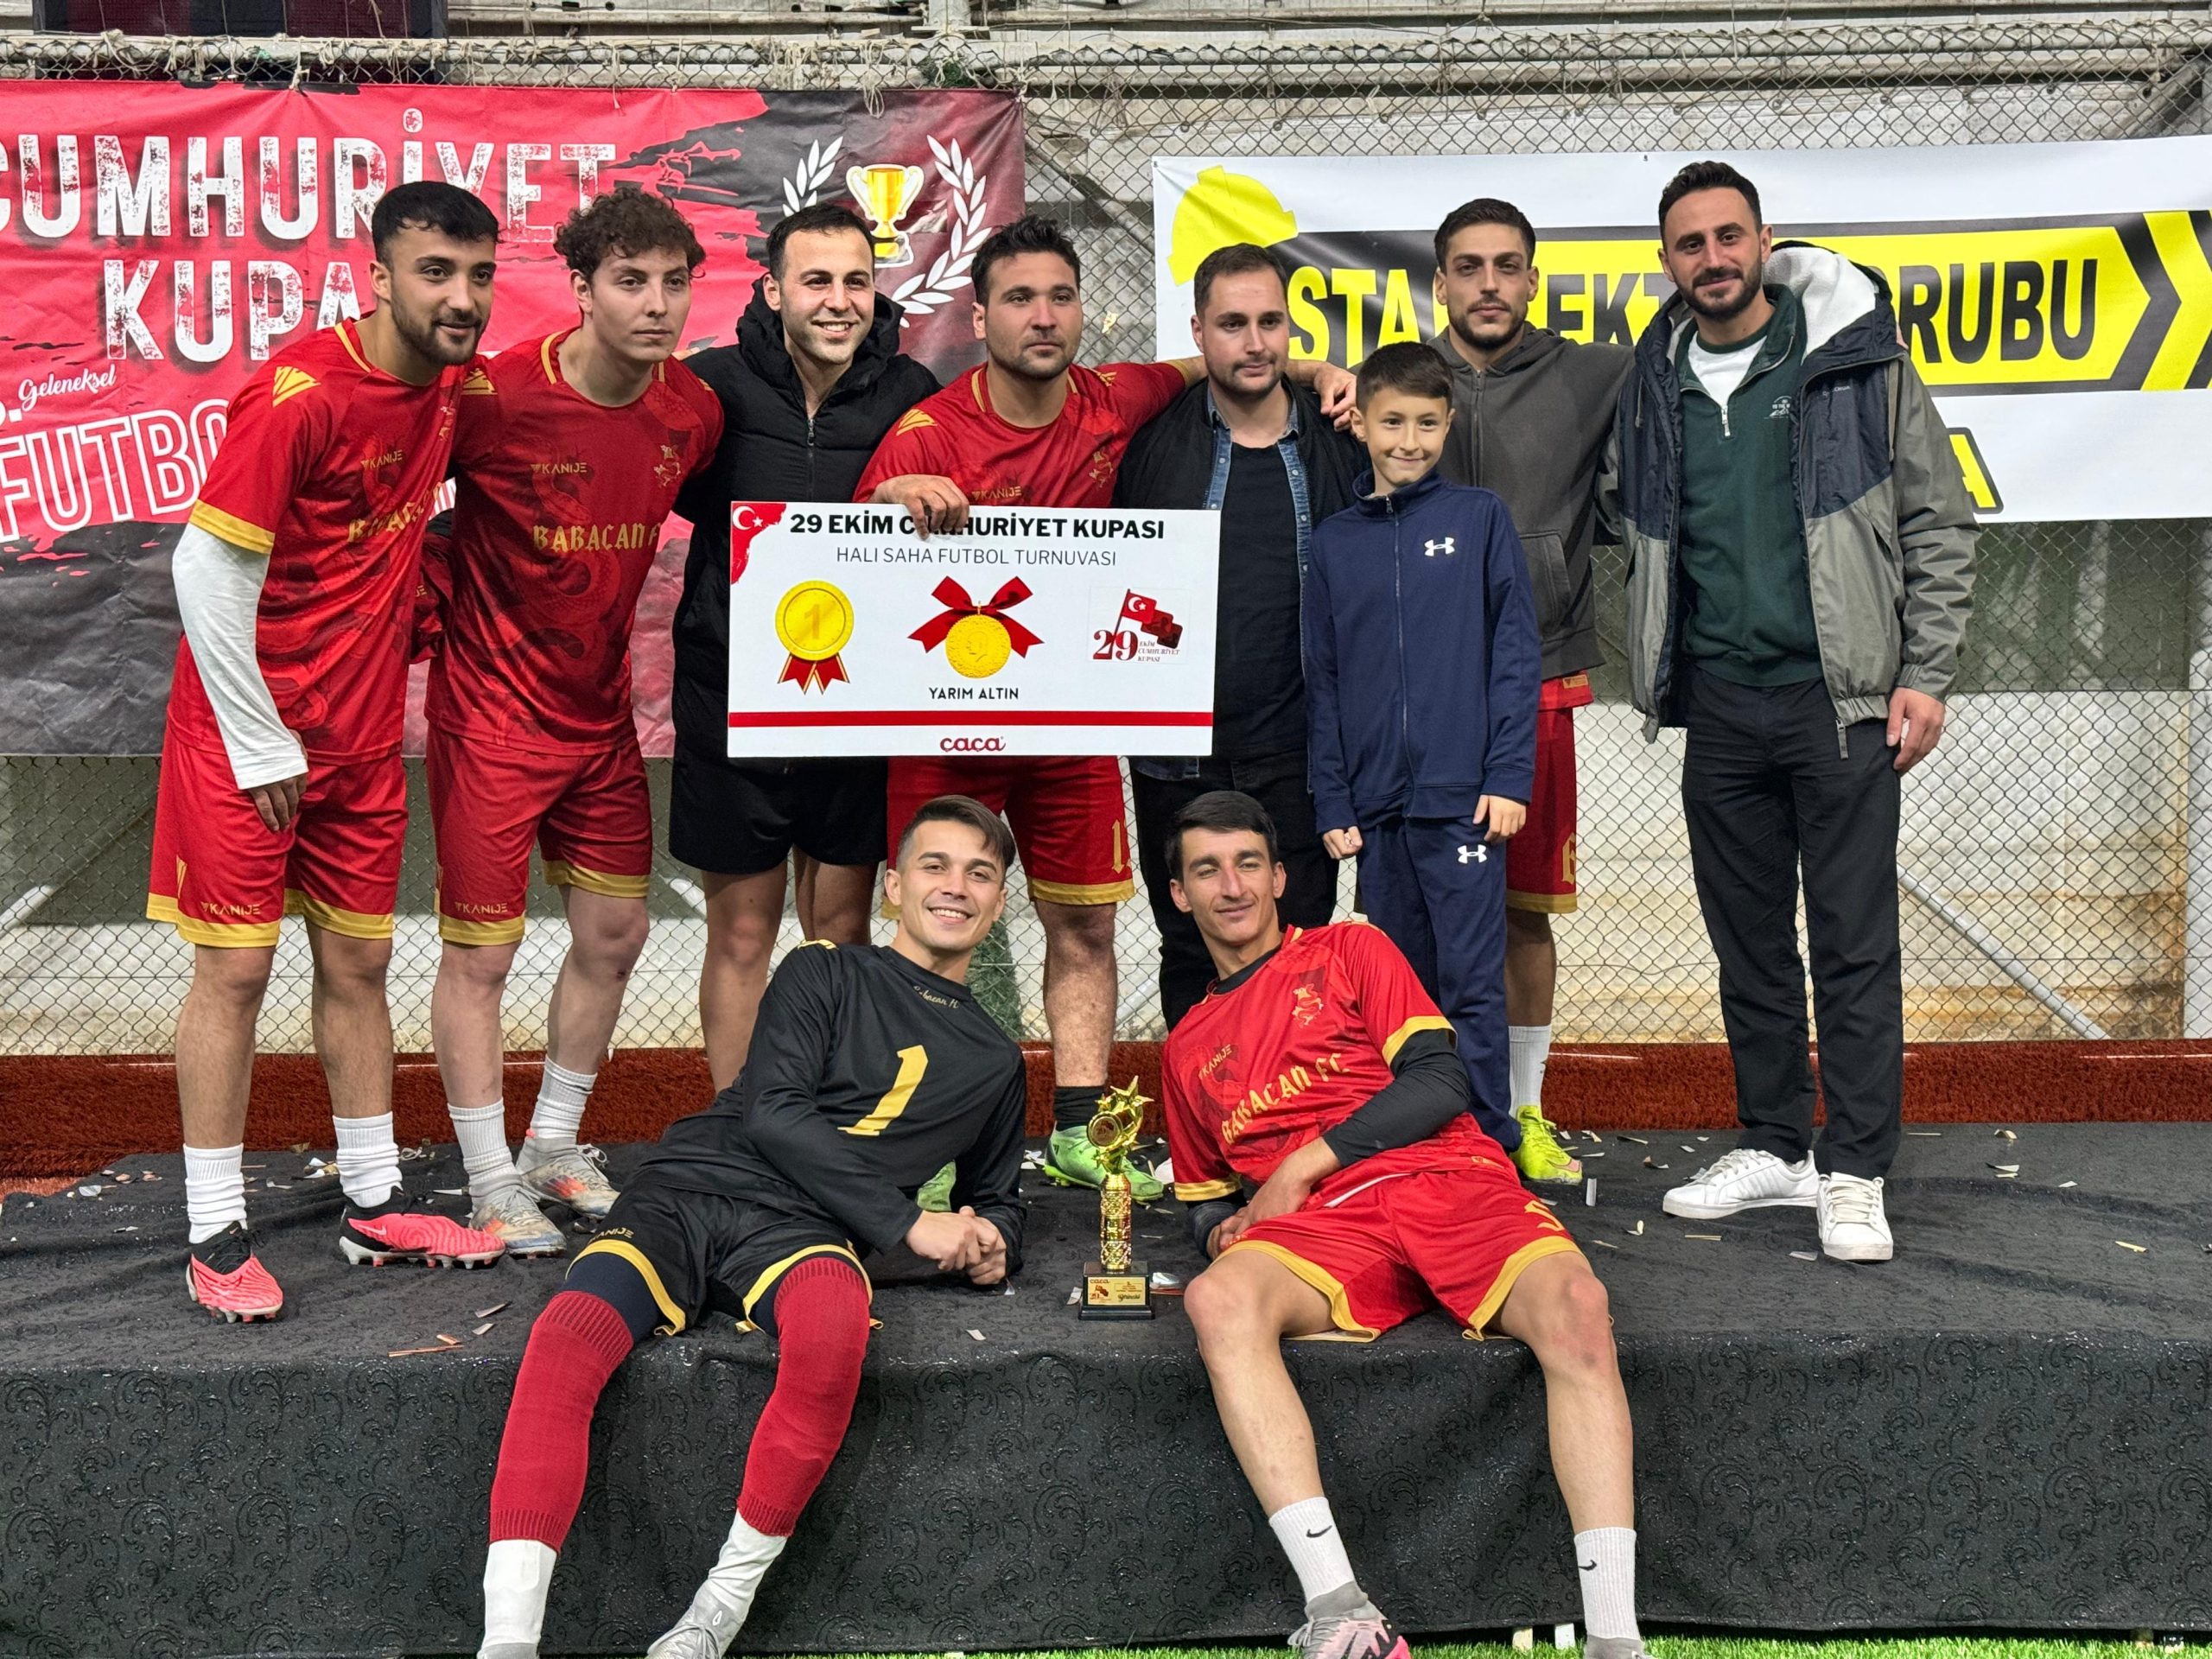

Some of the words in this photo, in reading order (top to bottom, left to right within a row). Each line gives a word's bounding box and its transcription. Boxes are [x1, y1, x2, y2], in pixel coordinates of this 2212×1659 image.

[0, 107, 616, 243] UMHURİYET
[103, 259, 361, 362] KUPA
[1287, 265, 1449, 369] STA
[1871, 258, 2098, 364] RUBU
[18, 365, 117, 410] Geleneksel
[533, 522, 645, 553] BABACAN
[790, 514, 821, 533] 29
[829, 510, 893, 534] EKİM
[899, 512, 1067, 537] CHURİYET
[1073, 519, 1165, 539] KUPASI
[836, 547, 878, 563] HALI
[883, 548, 934, 563] SAHA
[938, 548, 1009, 564] FUTBOL
[1014, 550, 1116, 566] TURNUVASI
[1093, 629, 1139, 661] 29
[928, 687, 974, 700] YARIM
[978, 687, 1020, 700] ALTIN
[836, 1044, 929, 1136] 1
